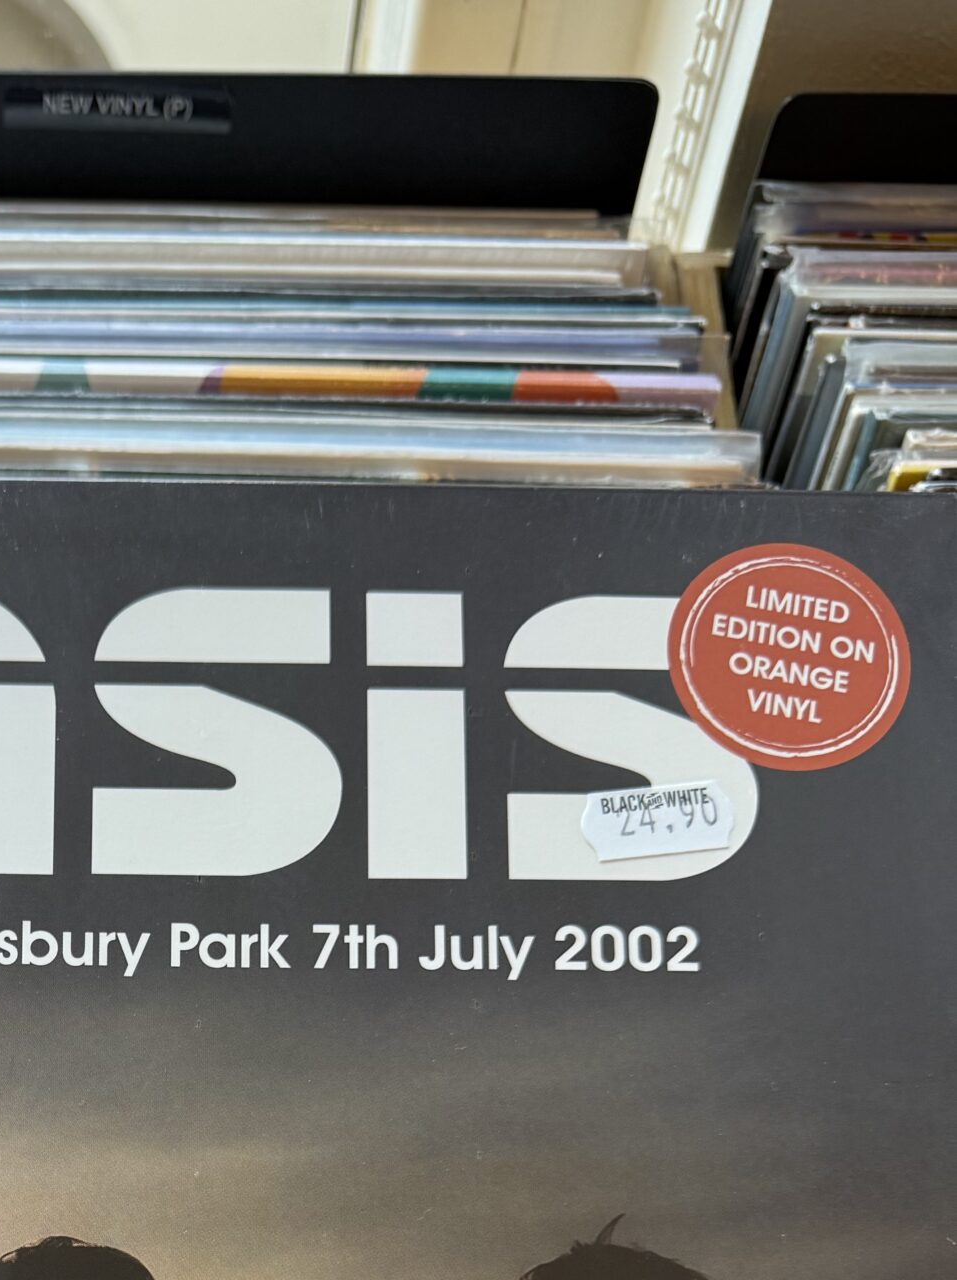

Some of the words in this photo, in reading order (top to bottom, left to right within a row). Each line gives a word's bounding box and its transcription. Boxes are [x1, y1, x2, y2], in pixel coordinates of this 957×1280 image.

[42, 93, 92, 116] NEW
[95, 94, 159, 117] VINYL
[746, 585, 850, 624] LIMITED
[711, 613, 821, 654] EDITION
[830, 636, 875, 663] ON
[728, 652, 850, 693] ORANGE
[747, 689, 822, 724] VINYL
[600, 794, 646, 815] BLACK
[663, 787, 710, 807] WHITE
[170, 922, 291, 969] Park
[312, 924, 399, 970] 7th
[418, 924, 535, 981] July
[554, 924, 701, 972] 2002
